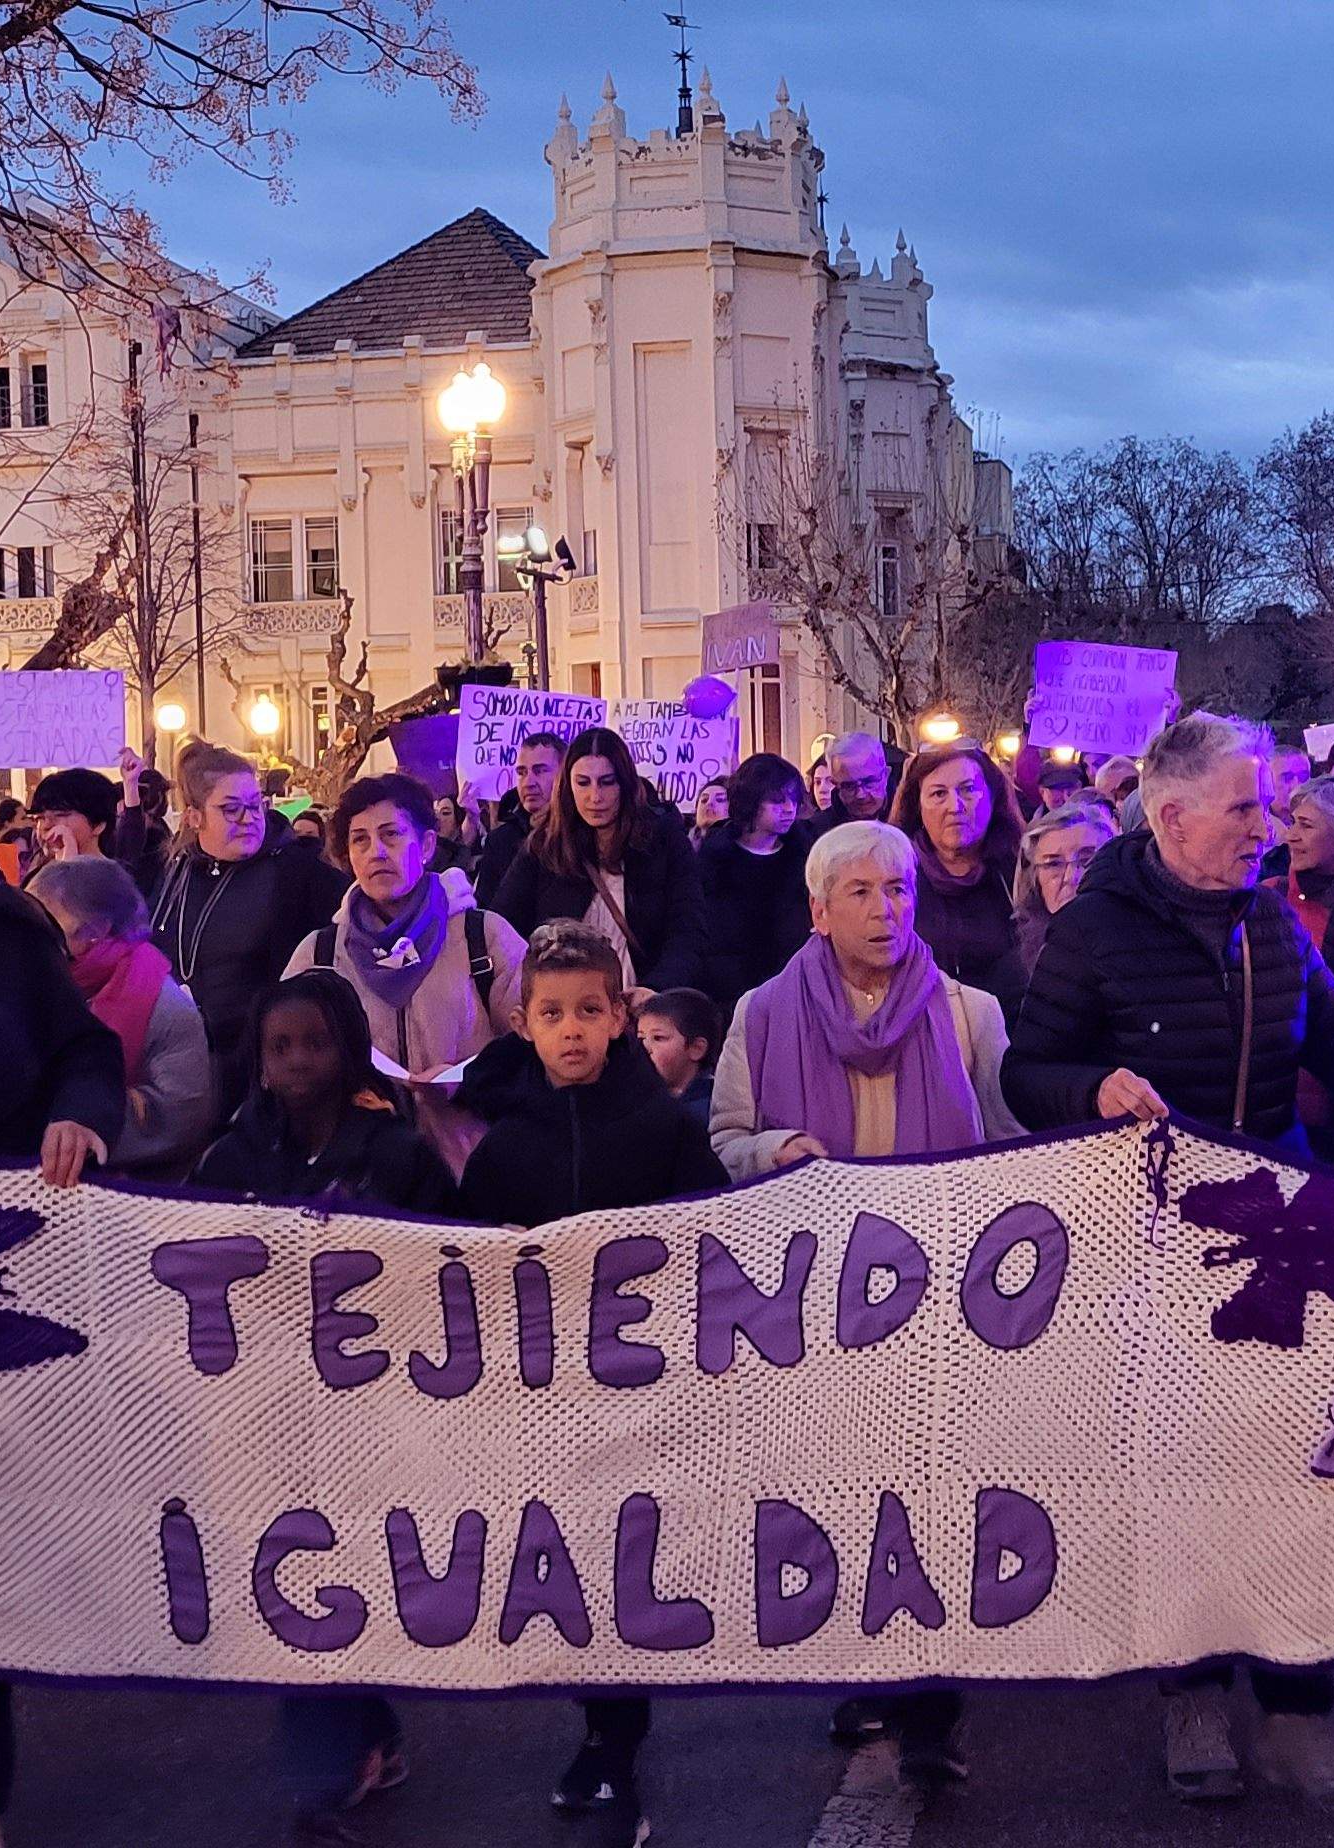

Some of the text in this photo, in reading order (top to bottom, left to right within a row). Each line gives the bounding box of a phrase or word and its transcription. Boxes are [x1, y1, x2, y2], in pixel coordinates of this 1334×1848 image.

[469, 690, 603, 723] SOMOS LAS NIETAS
[613, 702, 622, 717] A
[473, 722, 504, 745] DE
[680, 719, 710, 740] LAS
[475, 746, 498, 766] QUE
[499, 745, 517, 766] NO
[676, 741, 695, 764] NO
